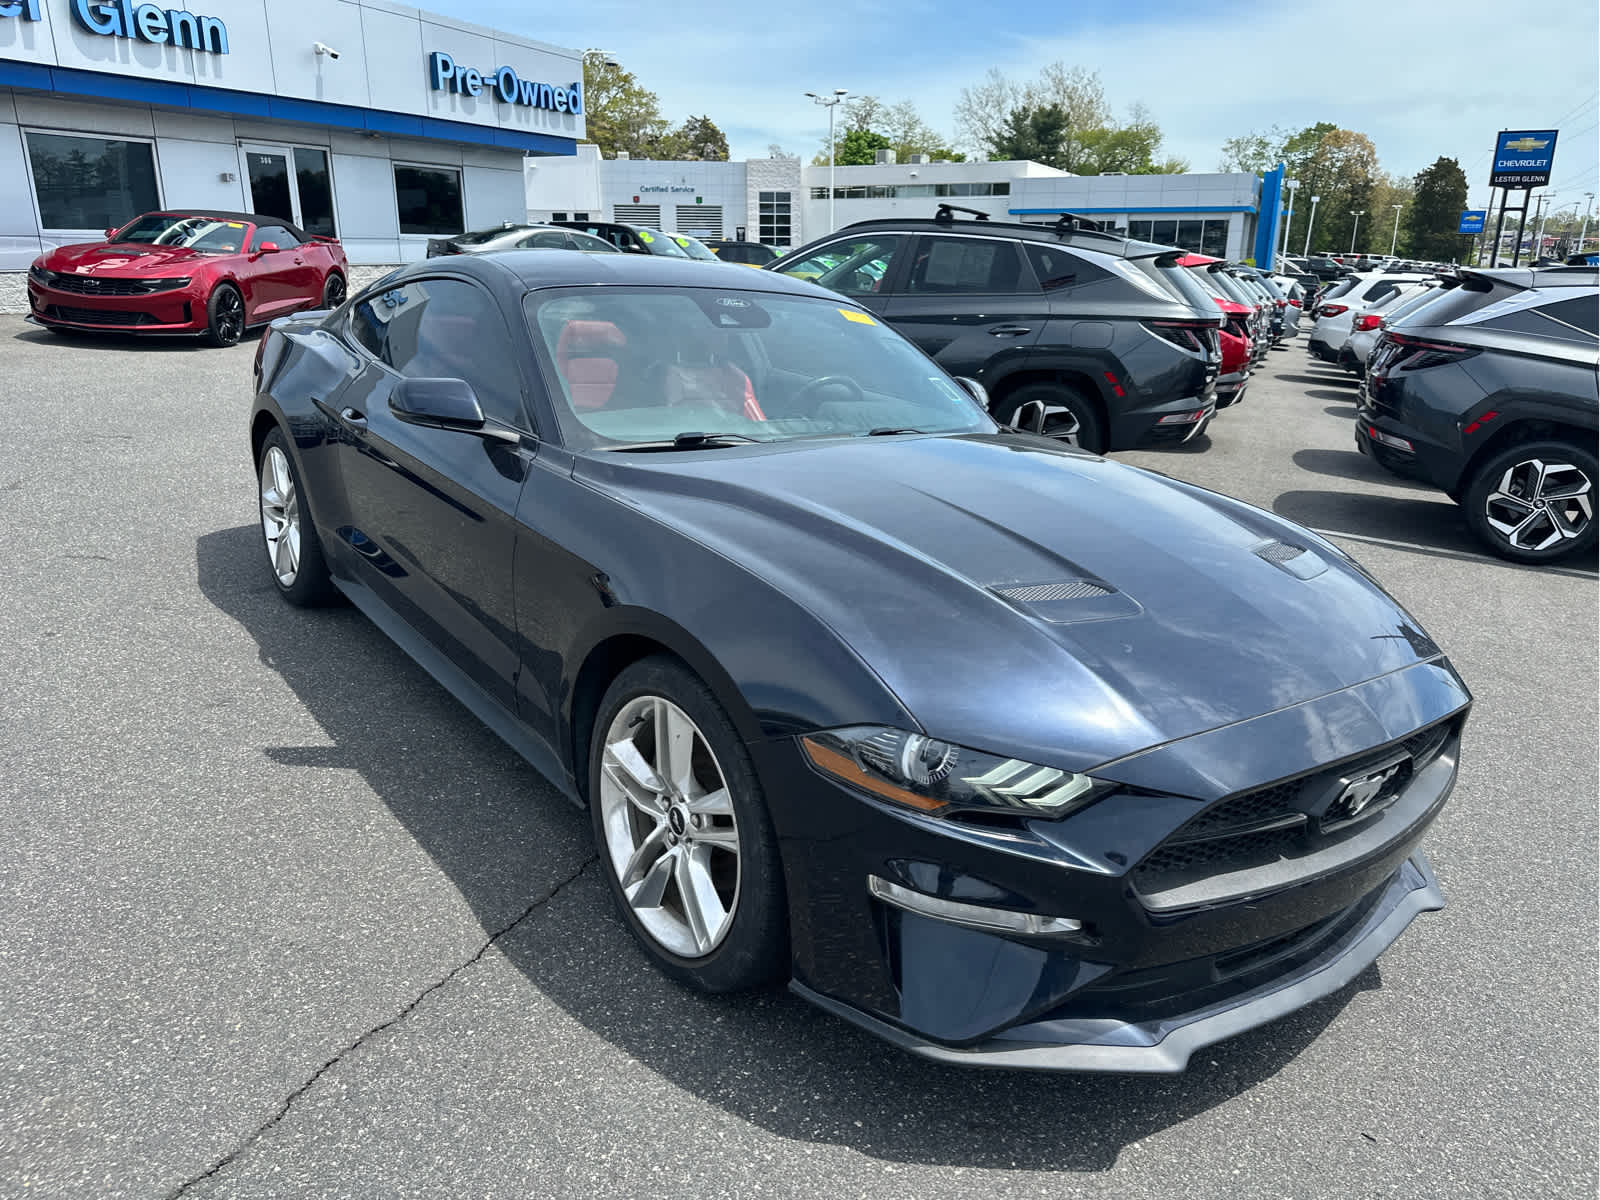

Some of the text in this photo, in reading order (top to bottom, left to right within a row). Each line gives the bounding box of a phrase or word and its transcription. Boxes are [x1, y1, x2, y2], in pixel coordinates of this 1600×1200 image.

[70, 0, 229, 54] Glenn
[430, 52, 581, 114] Pre-Owned
[1498, 159, 1547, 167] CHEVROLET
